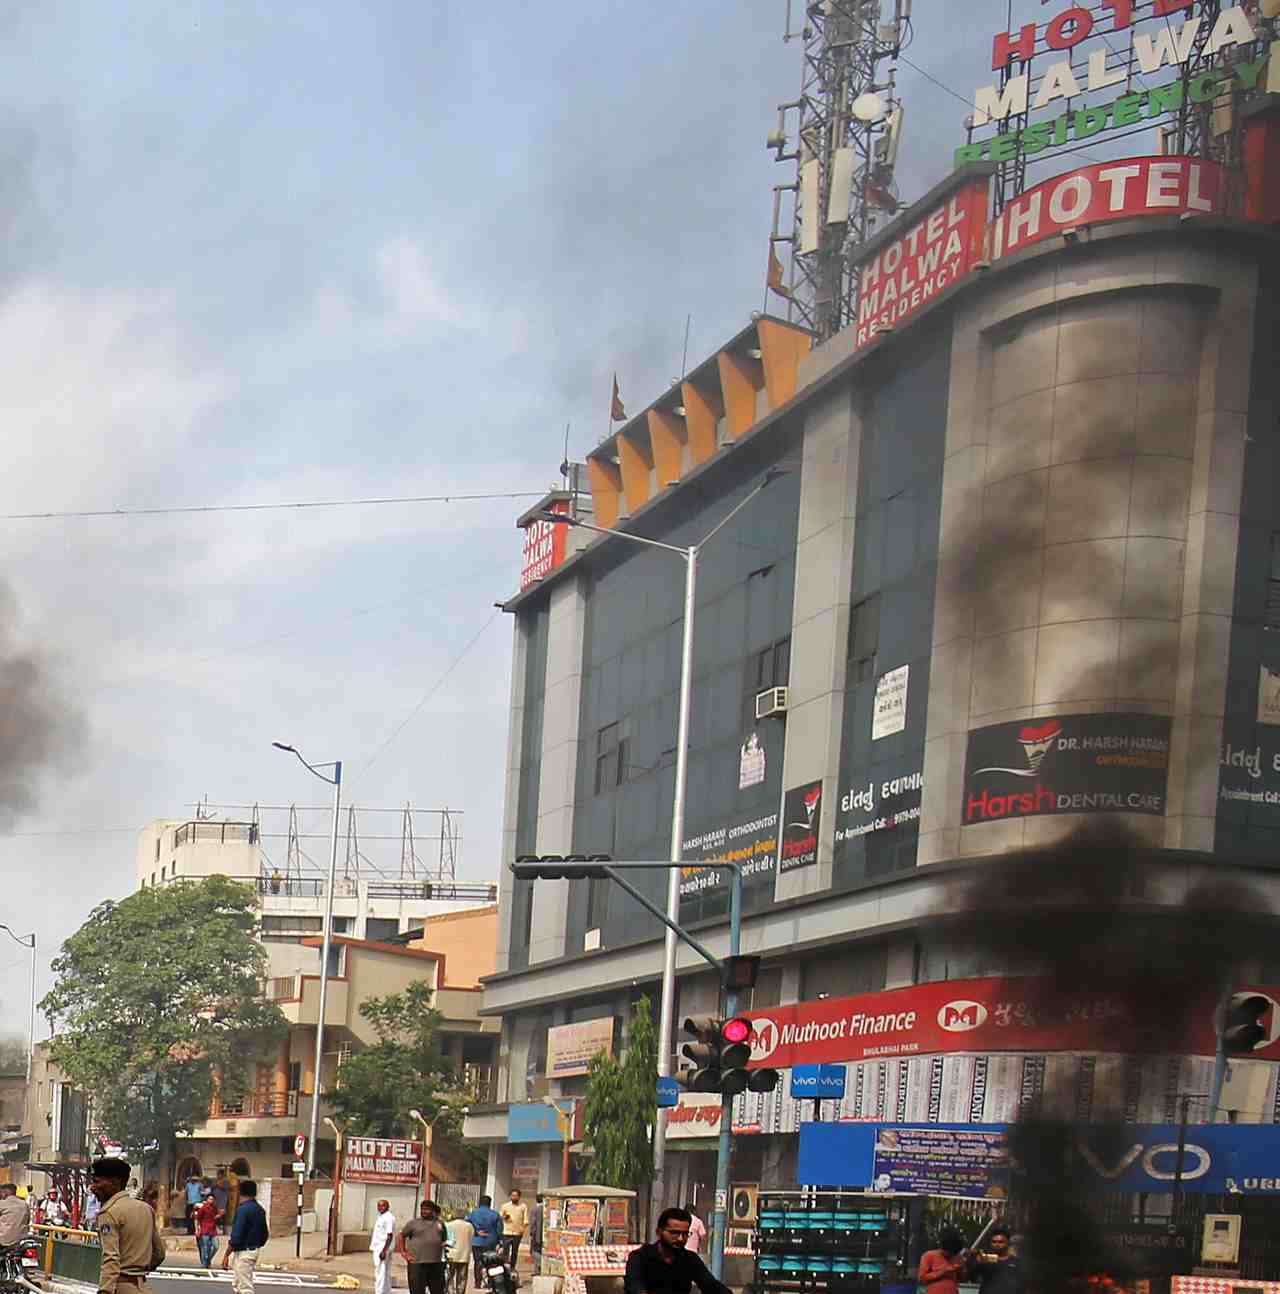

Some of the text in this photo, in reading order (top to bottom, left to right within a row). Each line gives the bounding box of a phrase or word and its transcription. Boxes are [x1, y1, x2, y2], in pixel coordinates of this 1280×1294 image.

[972, 5, 1256, 128] MALWA
[954, 53, 1268, 171] RESIDENCY
[1007, 163, 1213, 248] HOTEL
[862, 196, 966, 294] HOTEL
[859, 229, 962, 325] MALWA
[857, 259, 960, 346] RESIDENCY
[1058, 738, 1080, 750] DR.
[1083, 736, 1129, 750] HARSH
[966, 785, 1161, 819] Harsh DENTAL CARE
[683, 835, 703, 851] HARSH
[728, 814, 778, 839] ORTHODONTIST
[780, 1009, 916, 1045] Muthoot Finance
[793, 1076, 817, 1086] vivo
[820, 1077, 844, 1087] vivo
[345, 1156, 420, 1175] MALWA RESIDENCY
[347, 1139, 418, 1159] HOTEL
